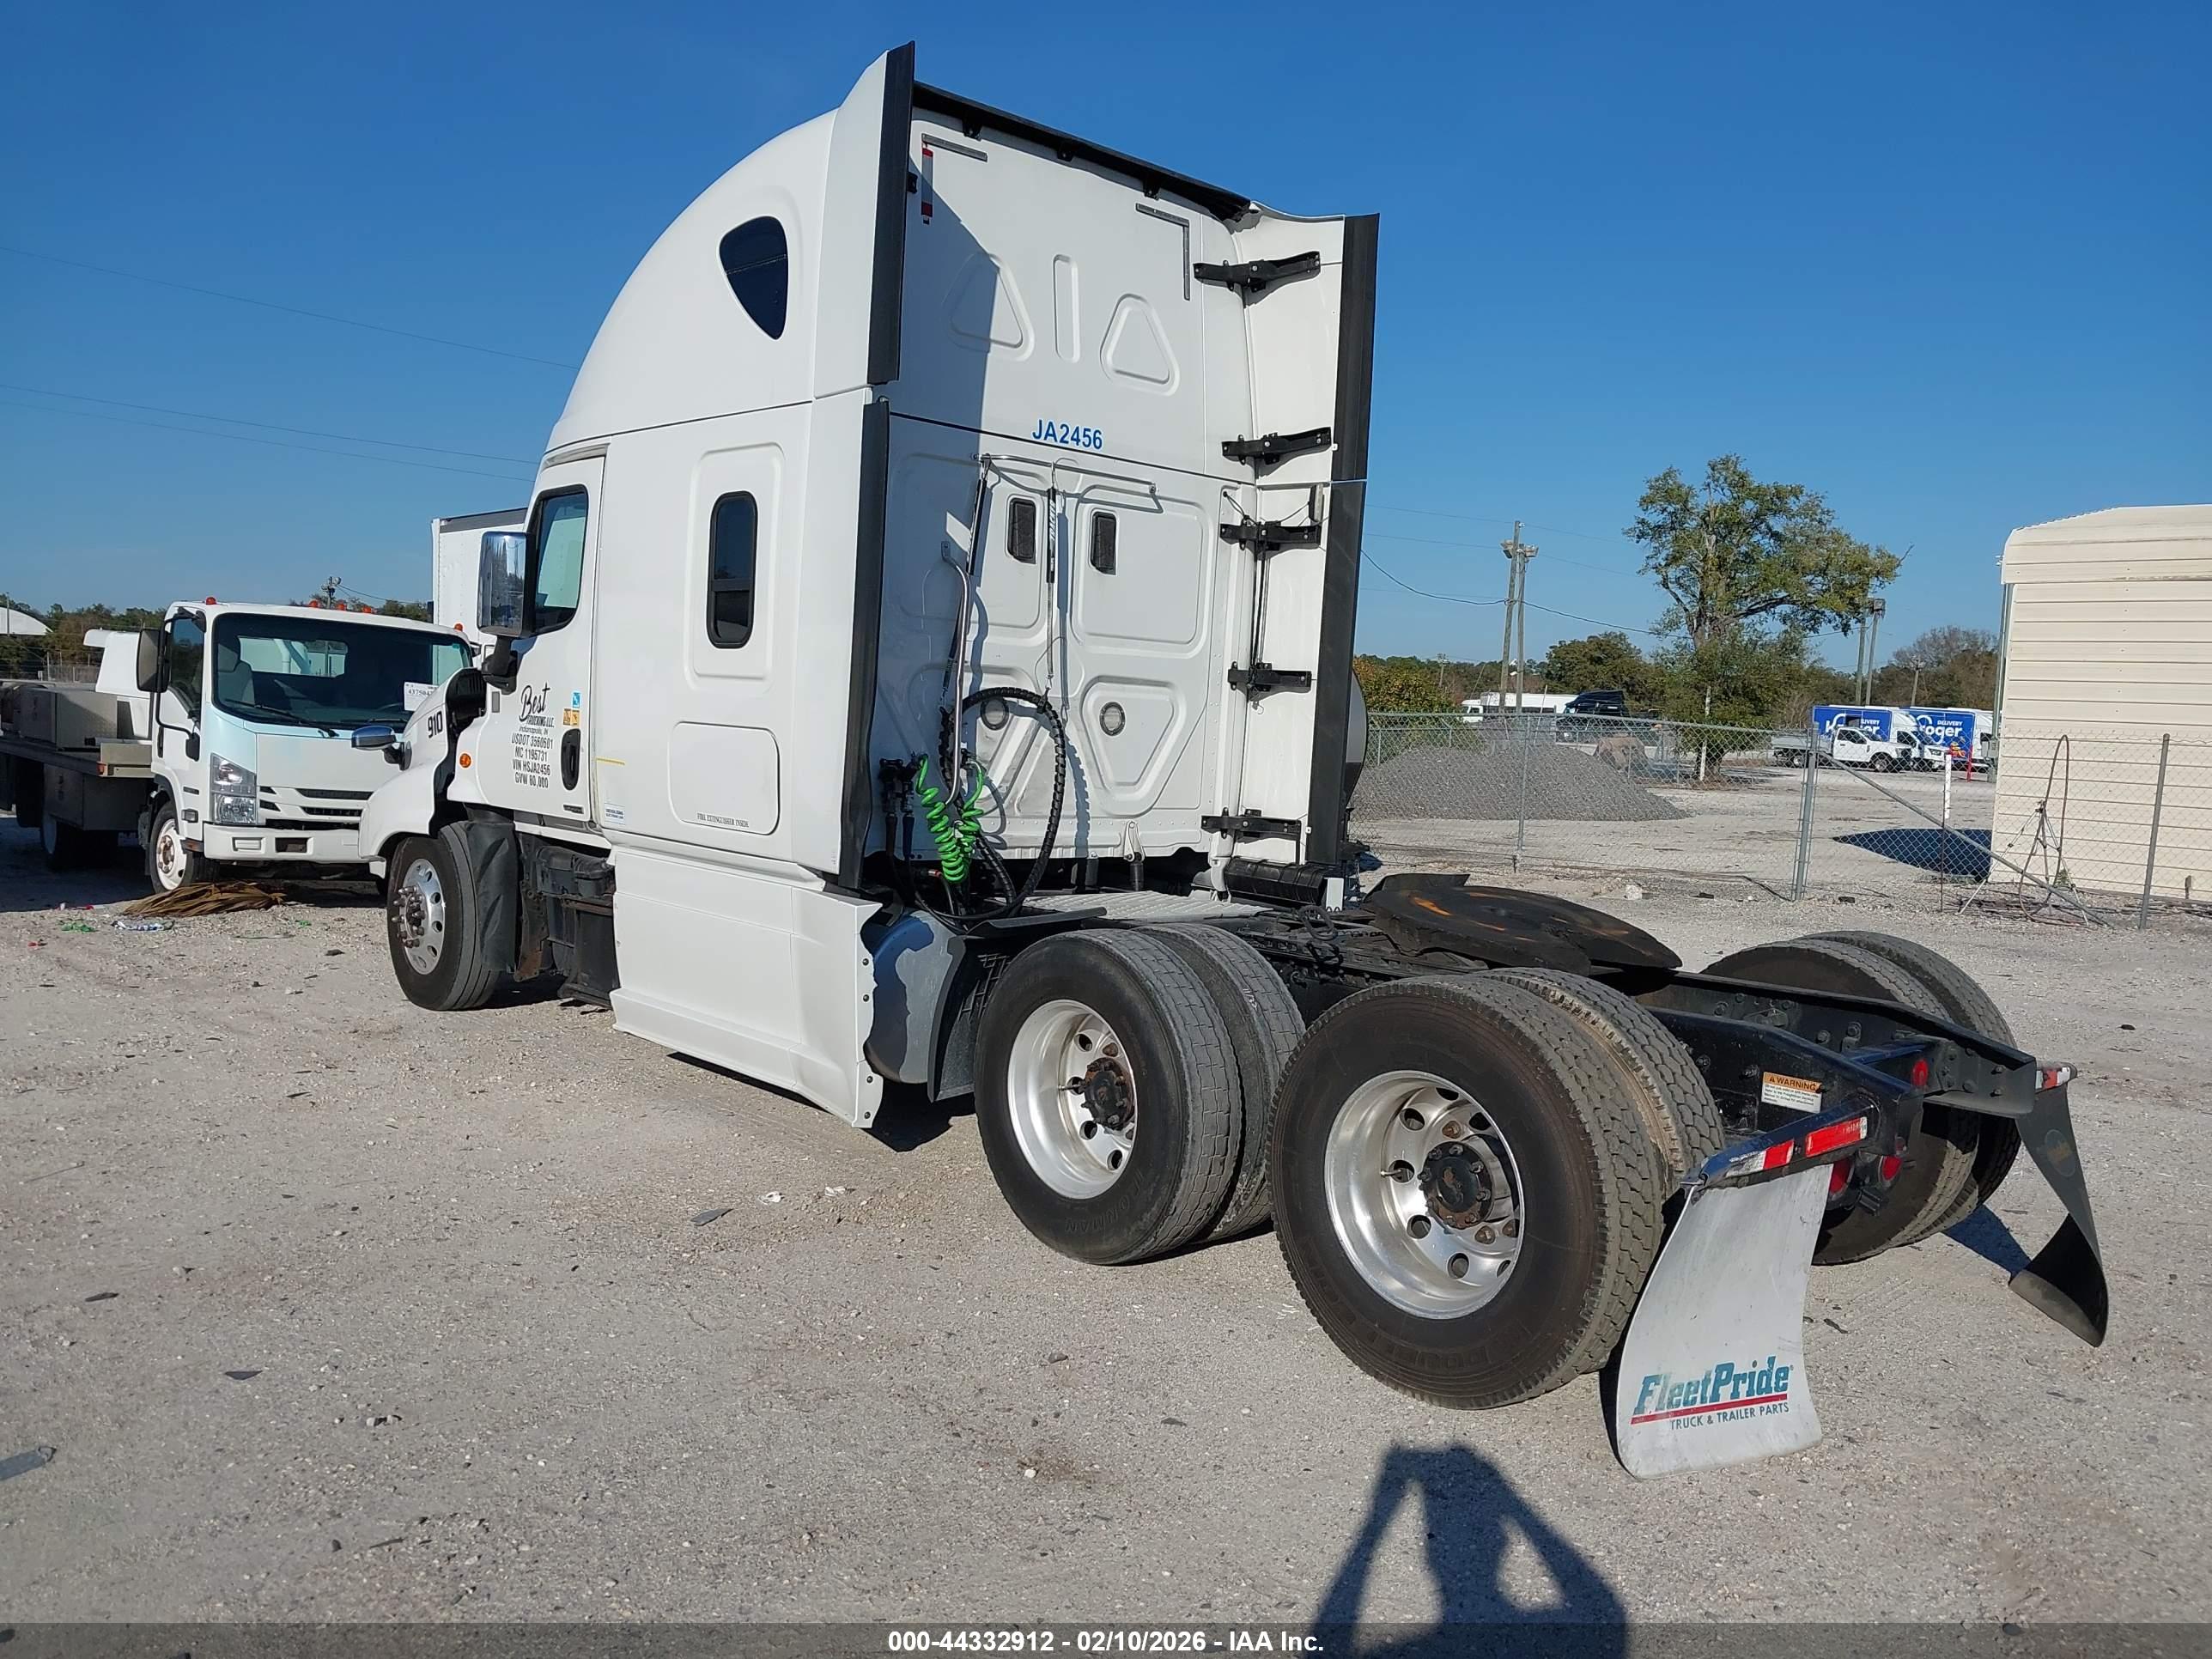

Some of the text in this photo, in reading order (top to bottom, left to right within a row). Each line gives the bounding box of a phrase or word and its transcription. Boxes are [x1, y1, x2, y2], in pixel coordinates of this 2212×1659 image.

[1032, 419, 1103, 450] JA2456
[519, 682, 550, 722] Best
[427, 710, 443, 738] 910
[511, 732, 530, 745] USDOT
[514, 745, 548, 763] MC 1195731
[512, 758, 551, 775] VIN HSJA2456
[514, 771, 528, 785] GVW
[1777, 1076, 1817, 1091] WARNING
[1633, 1355, 1790, 1416] FleetPride
[1670, 1402, 1790, 1431] TRUCK & TRAILER PARTS
